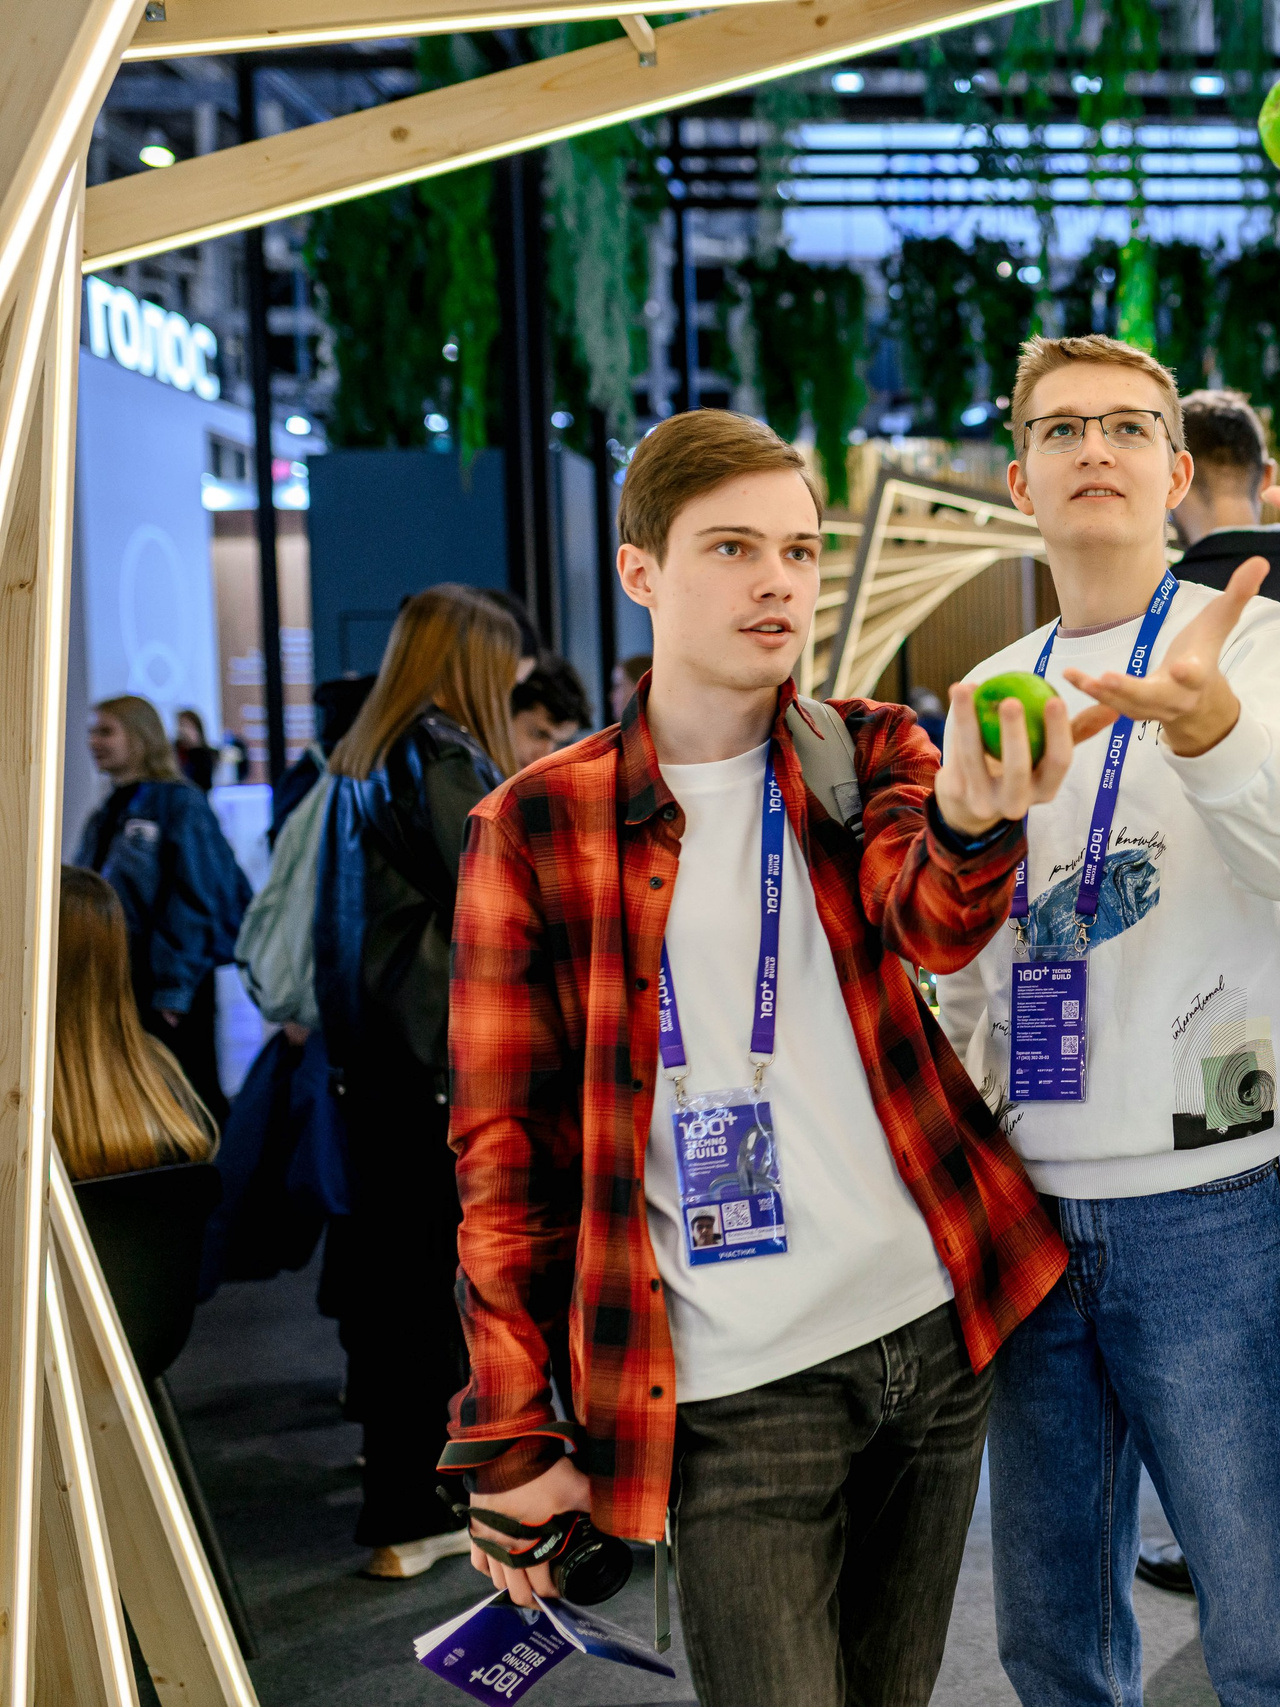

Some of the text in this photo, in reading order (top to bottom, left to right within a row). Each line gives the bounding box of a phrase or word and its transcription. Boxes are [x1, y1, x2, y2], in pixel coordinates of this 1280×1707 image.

[1132, 644, 1147, 676] 100+
[1109, 733, 1124, 767] 100+
[1103, 768, 1111, 789] BUILD
[768, 780, 782, 813] 100+
[1090, 827, 1104, 862] 100+
[772, 854, 780, 876] BUILD
[1084, 863, 1092, 884] BUILD
[764, 877, 779, 914] 100+
[768, 956, 776, 979] BUILD
[1018, 966, 1049, 982] 100+
[760, 980, 774, 1019] 100+
[685, 1136, 727, 1148] TECHNO
[686, 1145, 728, 1160] BUILD
[502, 1652, 534, 1676] TECHNO
[512, 1642, 546, 1668] BUILD
[469, 1663, 524, 1698] 100+
